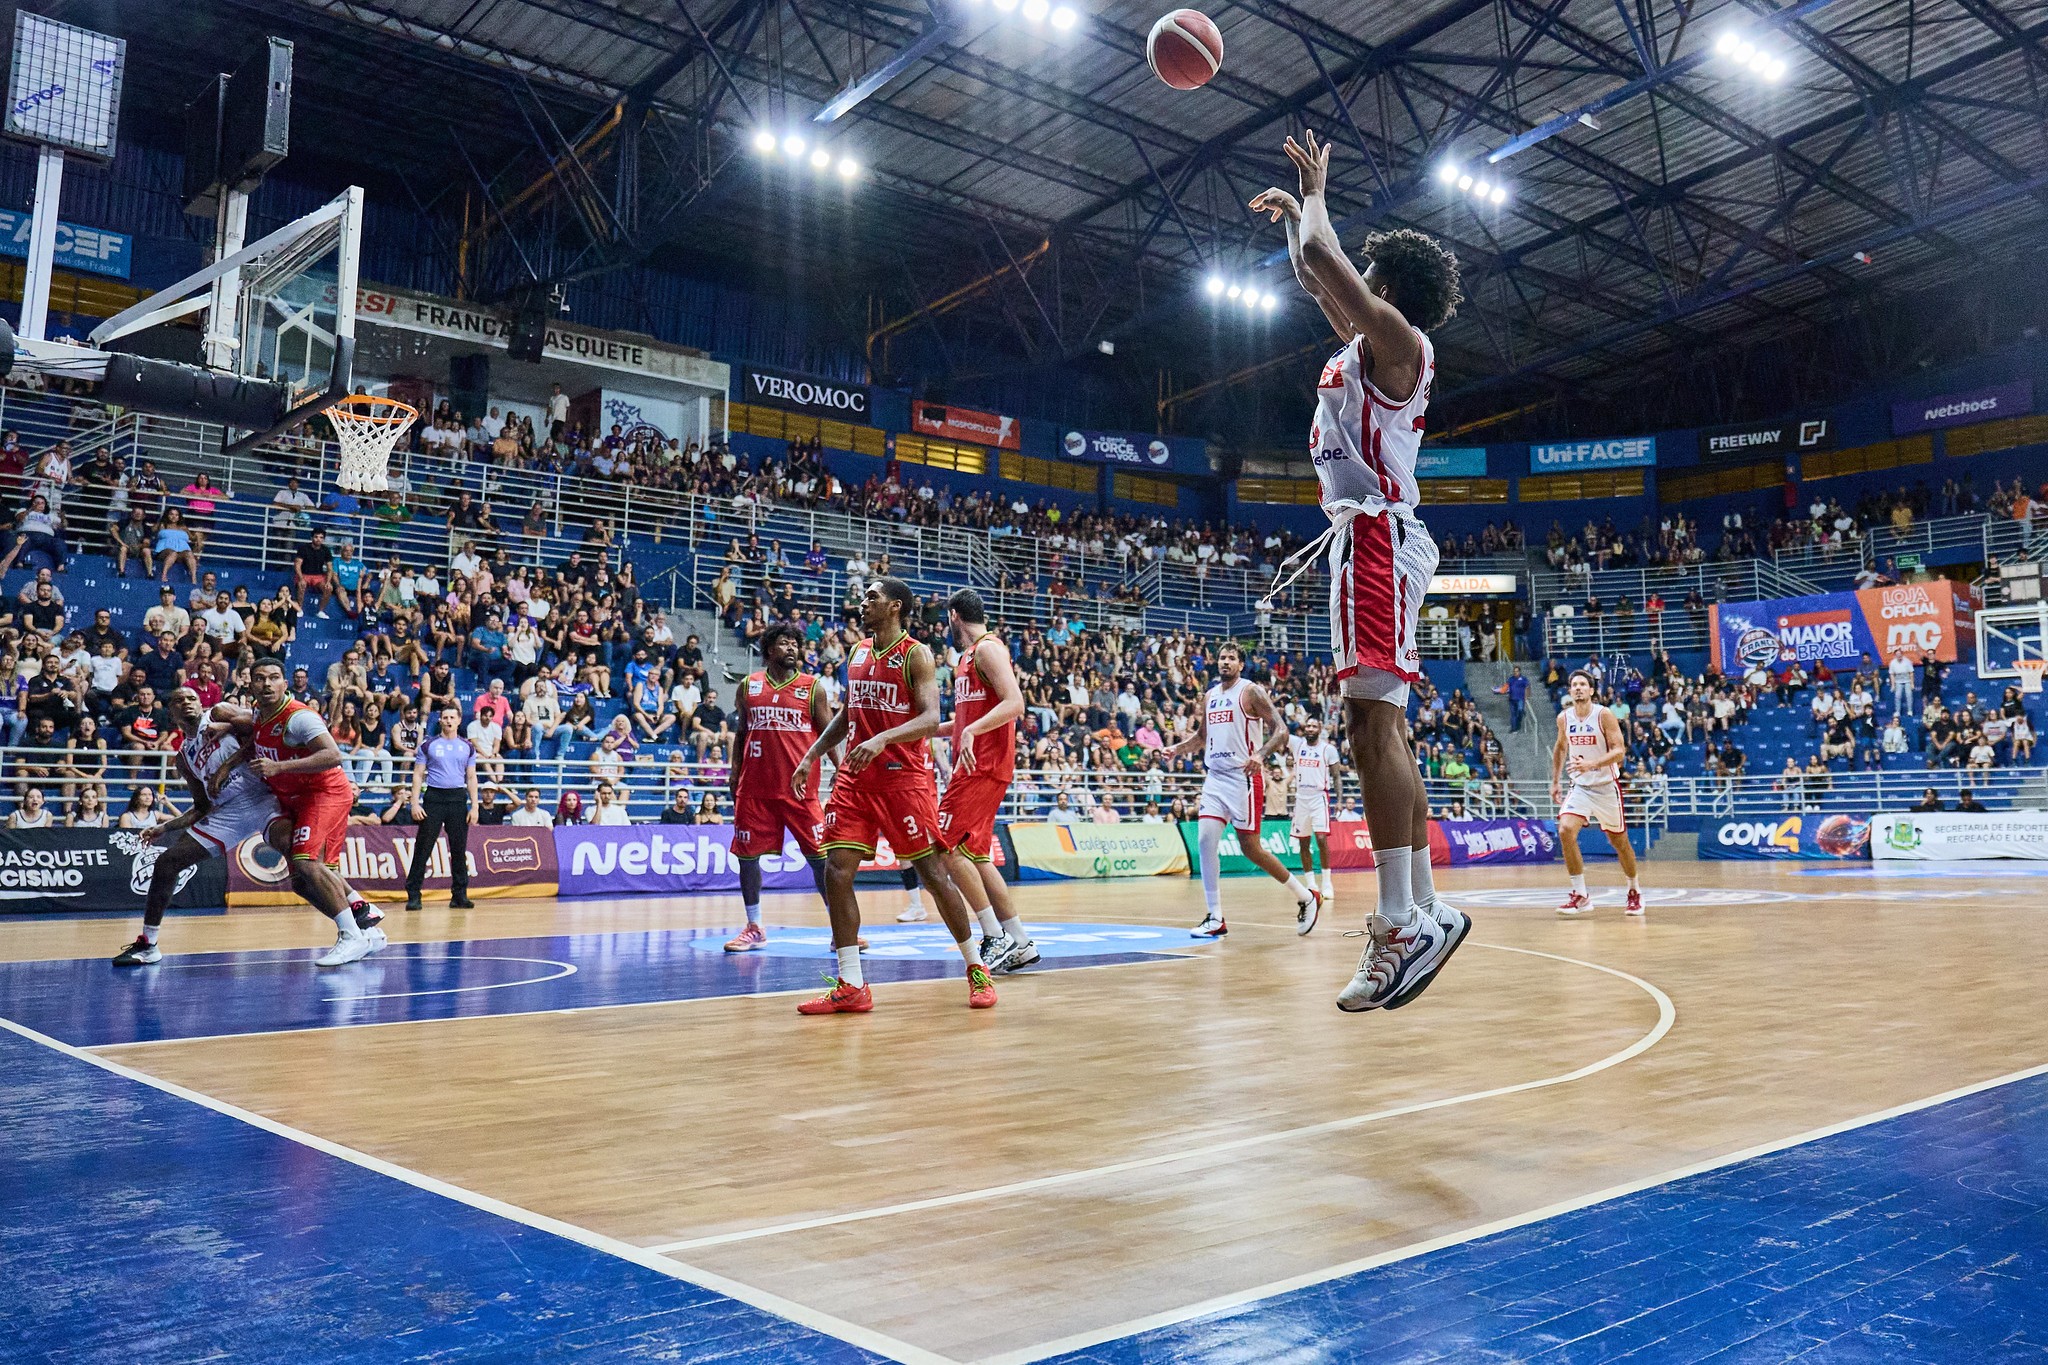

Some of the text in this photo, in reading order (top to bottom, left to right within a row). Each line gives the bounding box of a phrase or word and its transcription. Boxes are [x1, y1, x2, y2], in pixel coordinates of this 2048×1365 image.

[544, 330, 643, 365] ASQUETE
[752, 373, 865, 412] VEROMOC
[1709, 430, 1782, 450] FREEWAY
[1537, 440, 1650, 464] Uni-FACEF
[1883, 586, 1930, 606] LOJA
[1880, 601, 1939, 619] OFICIAL
[1780, 621, 1853, 646] MAIOR
[1780, 649, 1796, 662] do
[1796, 640, 1860, 661] BRASIL
[1209, 711, 1232, 724] SESI
[749, 741, 762, 757] 15
[1570, 736, 1594, 746] SESI
[903, 815, 918, 835] 3
[1935, 824, 1989, 833] SECRETARIA
[1991, 824, 2004, 832] DE
[1078, 837, 1159, 854] colégio piaget
[1946, 833, 2002, 844] RECREAÇÃO
[2013, 834, 2044, 842] LAZER
[0, 868, 83, 887] CISMO
